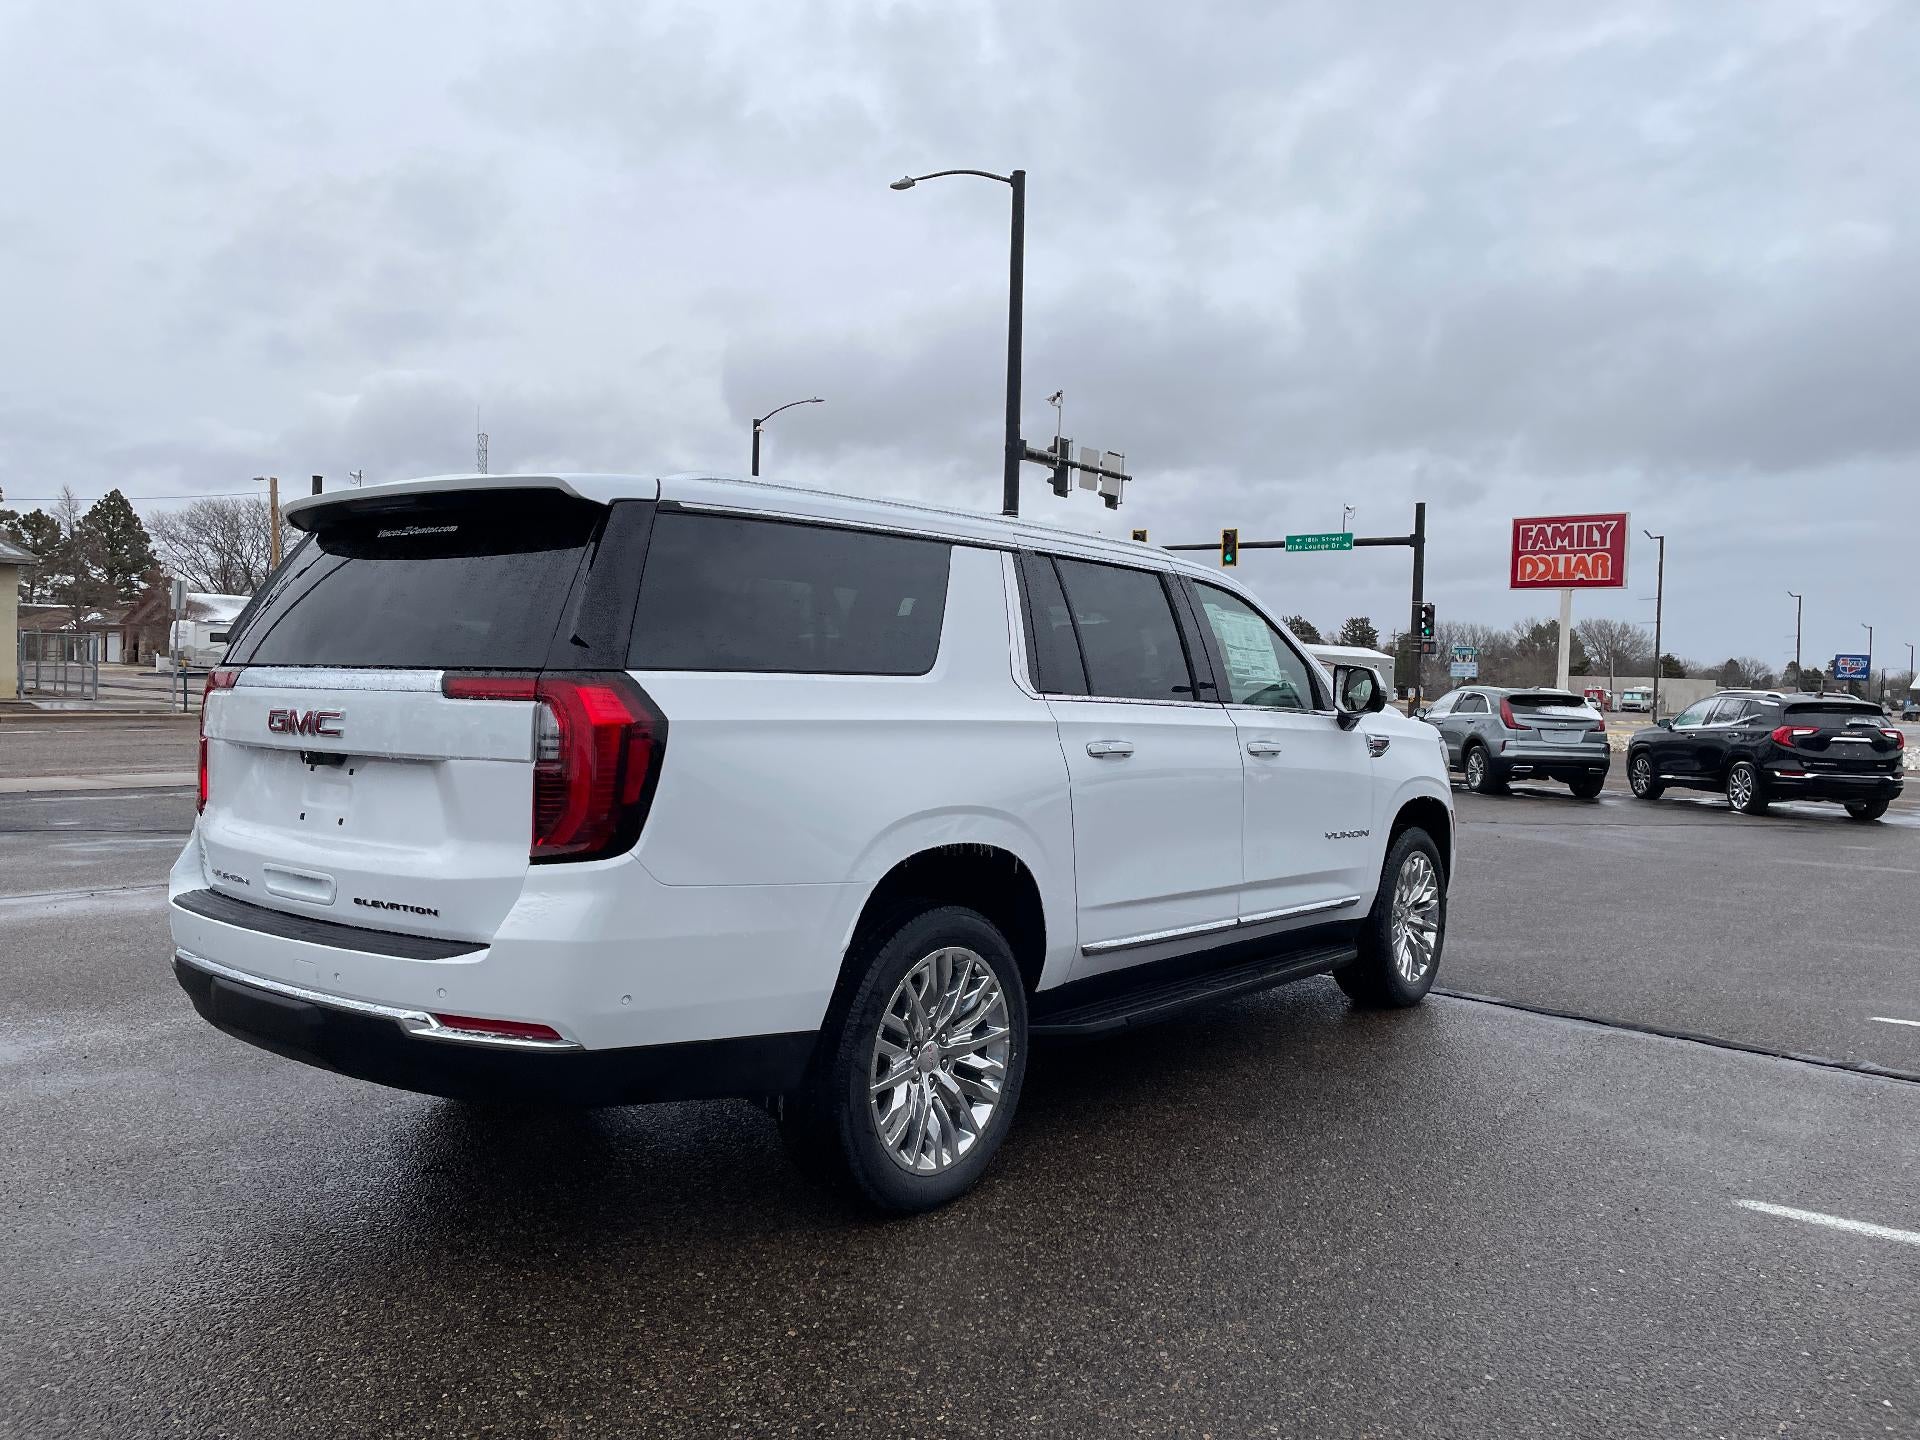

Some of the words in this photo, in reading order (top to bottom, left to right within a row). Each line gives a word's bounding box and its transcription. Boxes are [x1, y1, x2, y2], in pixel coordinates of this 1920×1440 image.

[1519, 521, 1618, 551] FAMILY
[1517, 552, 1612, 581] DOLLAR
[268, 707, 346, 738] GMC
[1324, 829, 1370, 840] YUKON
[353, 897, 440, 917] ELEVATION
